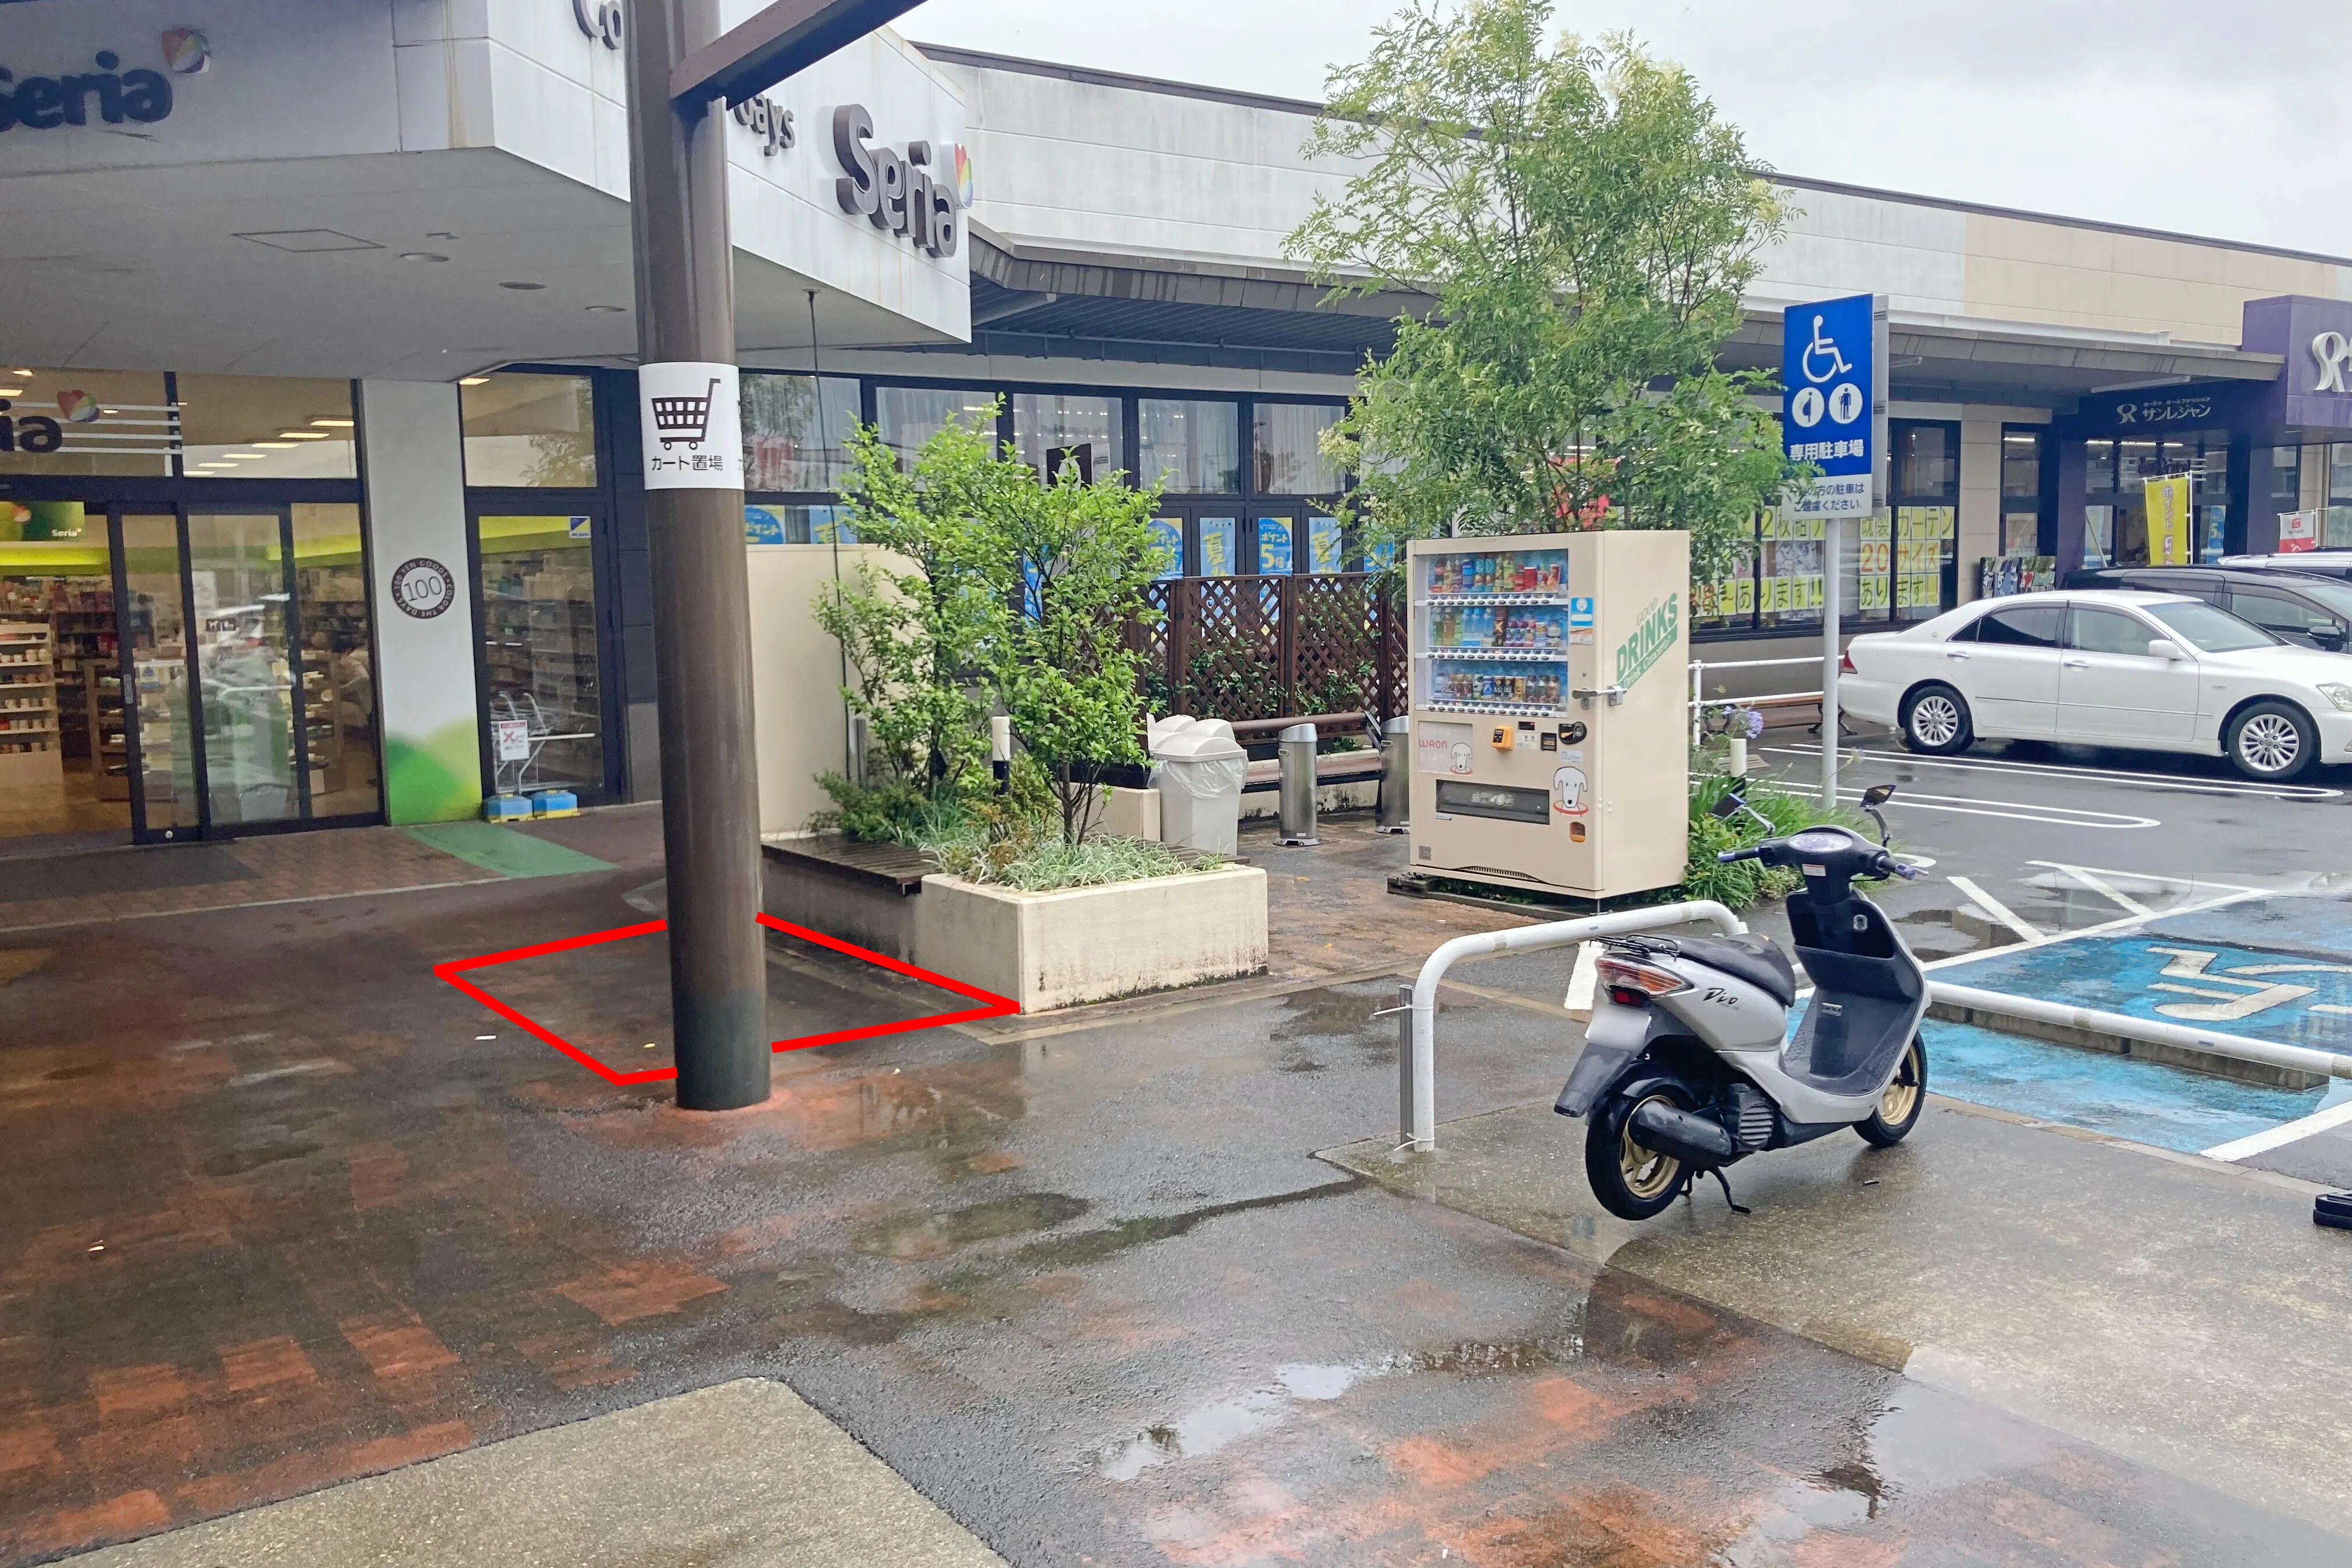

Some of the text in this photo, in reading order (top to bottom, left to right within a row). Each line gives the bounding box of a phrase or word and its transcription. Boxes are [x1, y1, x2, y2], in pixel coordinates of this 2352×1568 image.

[833, 103, 957, 258] Seria
[2142, 404, 2211, 422] サンレジャン
[0, 398, 62, 453] ia
[1790, 439, 1864, 461] 専用駐車場
[651, 456, 723, 471] カート置場
[1261, 532, 1289, 544] ポイント
[1261, 544, 1285, 569] 5倍
[404, 576, 442, 601] 100
[1636, 597, 1658, 626] GOOD
[1616, 592, 1678, 685] DRINKS
[1419, 740, 1447, 749] WAON
[1703, 988, 1738, 1005] Dio
